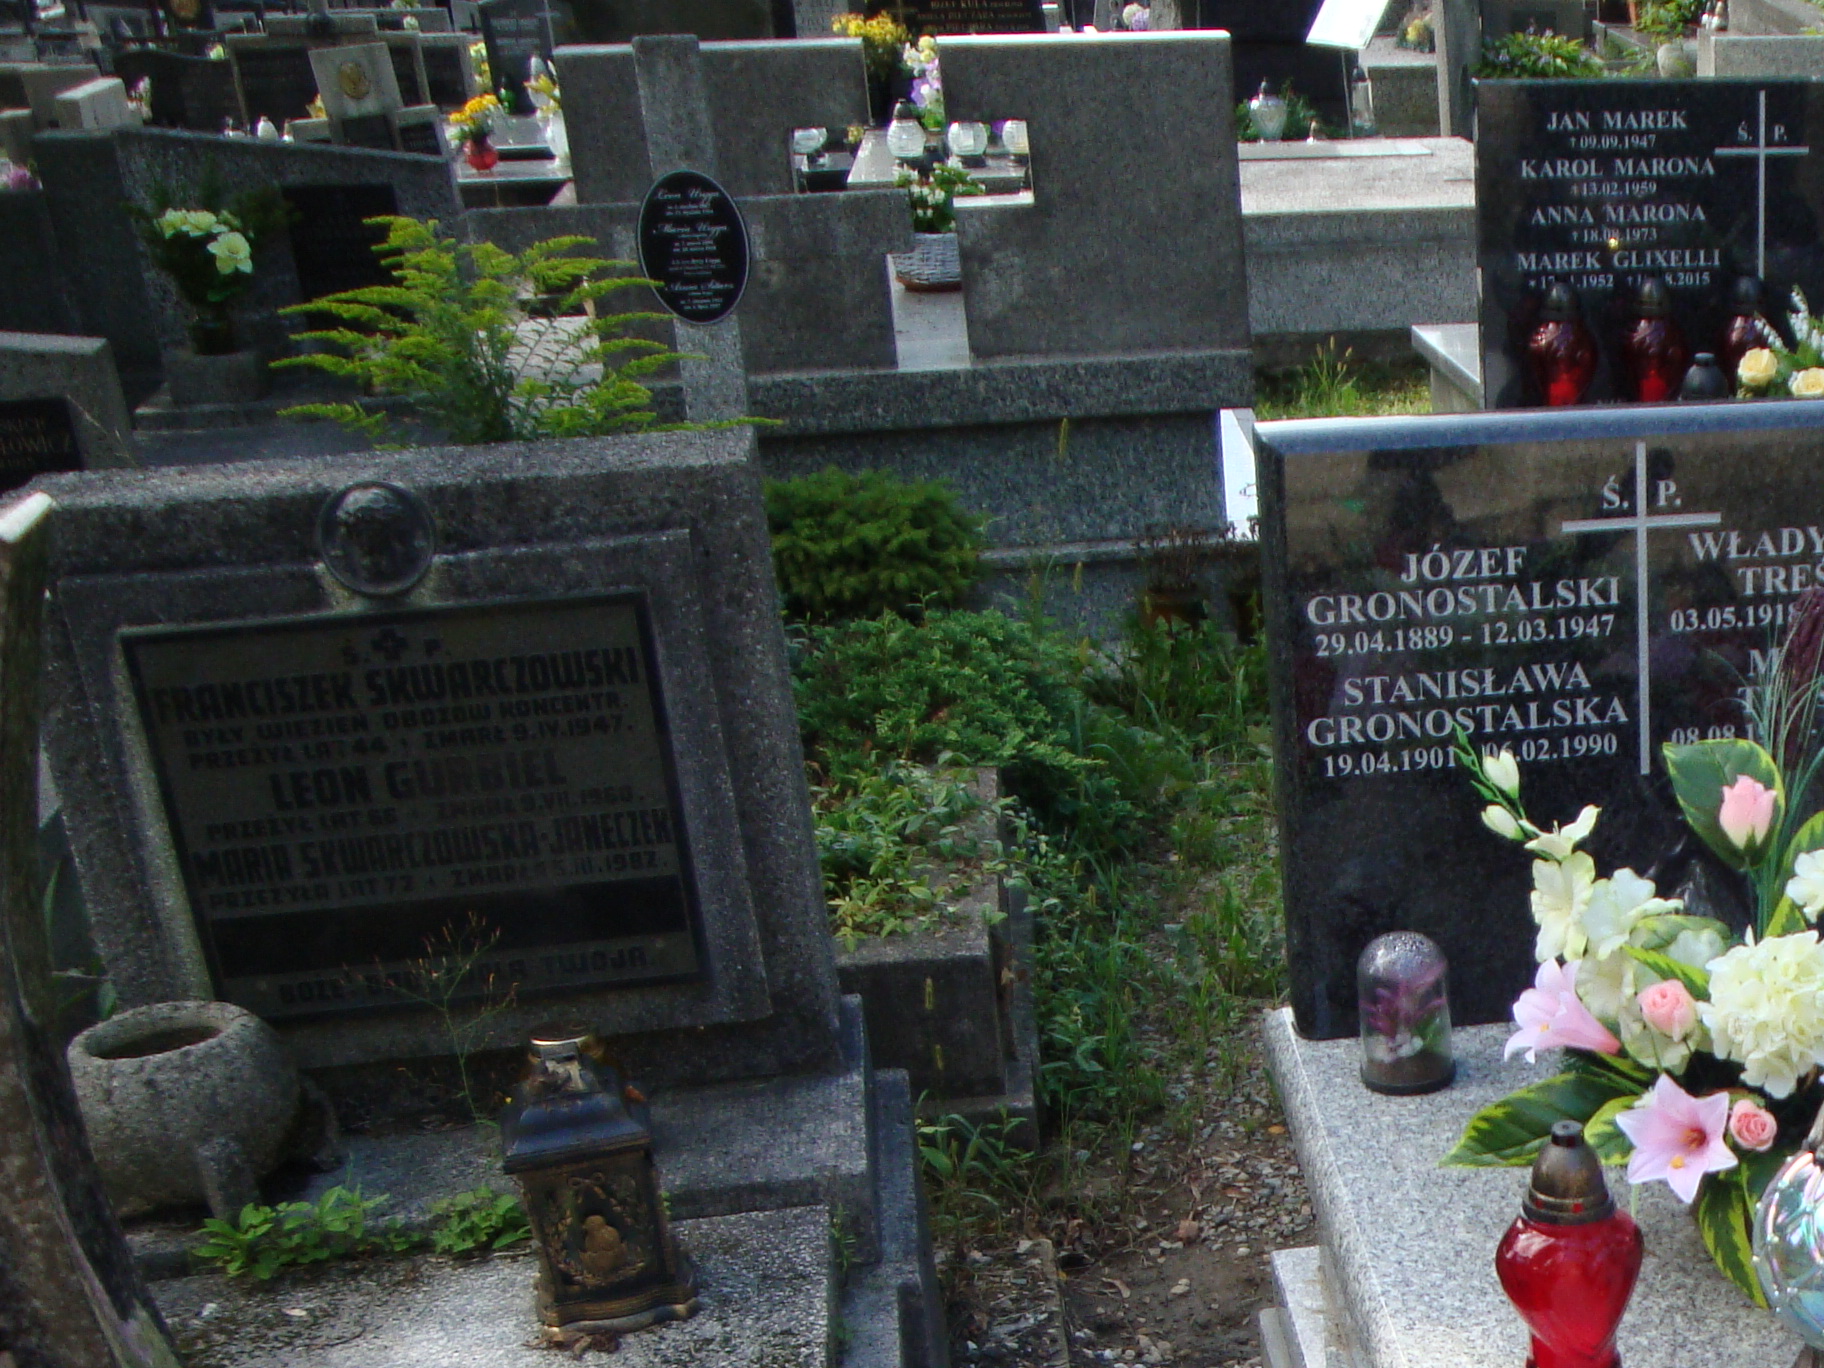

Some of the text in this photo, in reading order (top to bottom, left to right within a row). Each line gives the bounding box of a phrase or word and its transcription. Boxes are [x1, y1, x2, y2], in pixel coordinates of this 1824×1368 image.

[1546, 109, 1688, 132] JAN MAREK
[1736, 120, 1788, 142] Ś. P.
[1580, 134, 1657, 150] 09.09.1947
[1520, 155, 1716, 180] KAROL MARONA
[1581, 181, 1657, 198] 13.02.1959
[1531, 203, 1707, 227] ANNA MARONA
[1516, 247, 1721, 273] MAREK GLIXELLI
[1602, 478, 1683, 511] Ś. P.
[1400, 543, 1527, 584] JÓZEF
[1305, 576, 1621, 627] GRONOSTALSKI
[1315, 624, 1454, 659] 29.04.1889
[1481, 613, 1616, 647] 12.03.1947
[151, 646, 640, 728] FRANCISZEK SKWARCZOWSKI
[1343, 660, 1592, 708] STANISŁAWA
[1305, 695, 1630, 749] GRONOSTALSKA
[1324, 745, 1457, 779] 19.04.1901
[268, 764, 374, 813] LEON
[191, 846, 293, 889] MARIA
